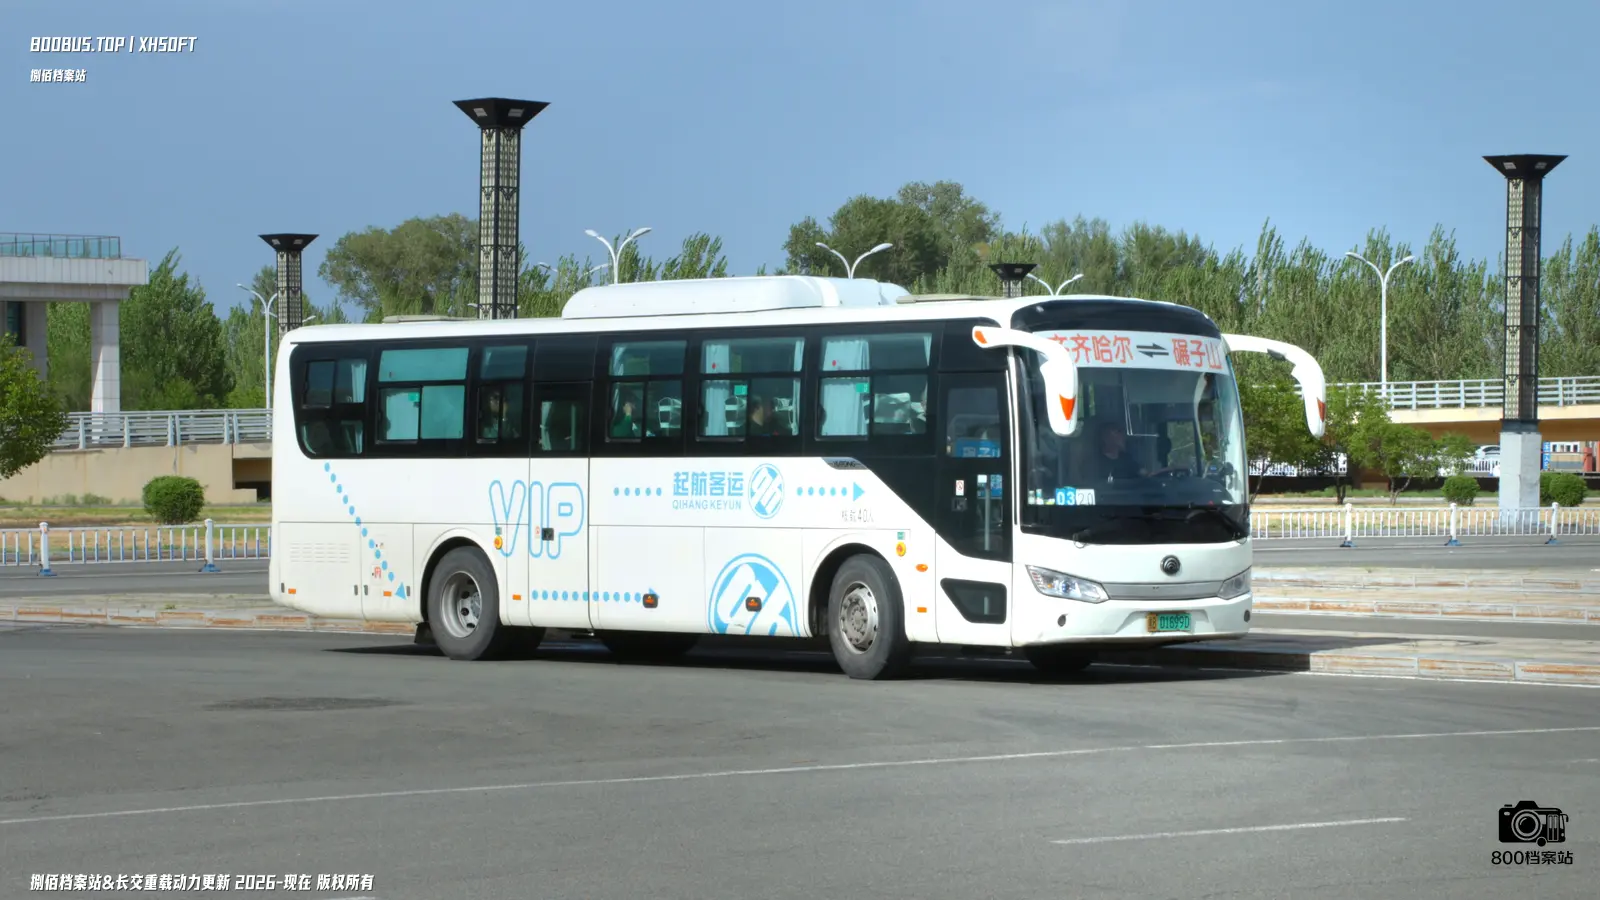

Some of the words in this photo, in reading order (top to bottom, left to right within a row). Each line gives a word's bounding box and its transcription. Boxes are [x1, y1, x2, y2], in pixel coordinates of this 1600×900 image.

[1171, 337, 1223, 370] 碾子山
[672, 470, 744, 497] 起航客运
[488, 479, 585, 560] VIP
